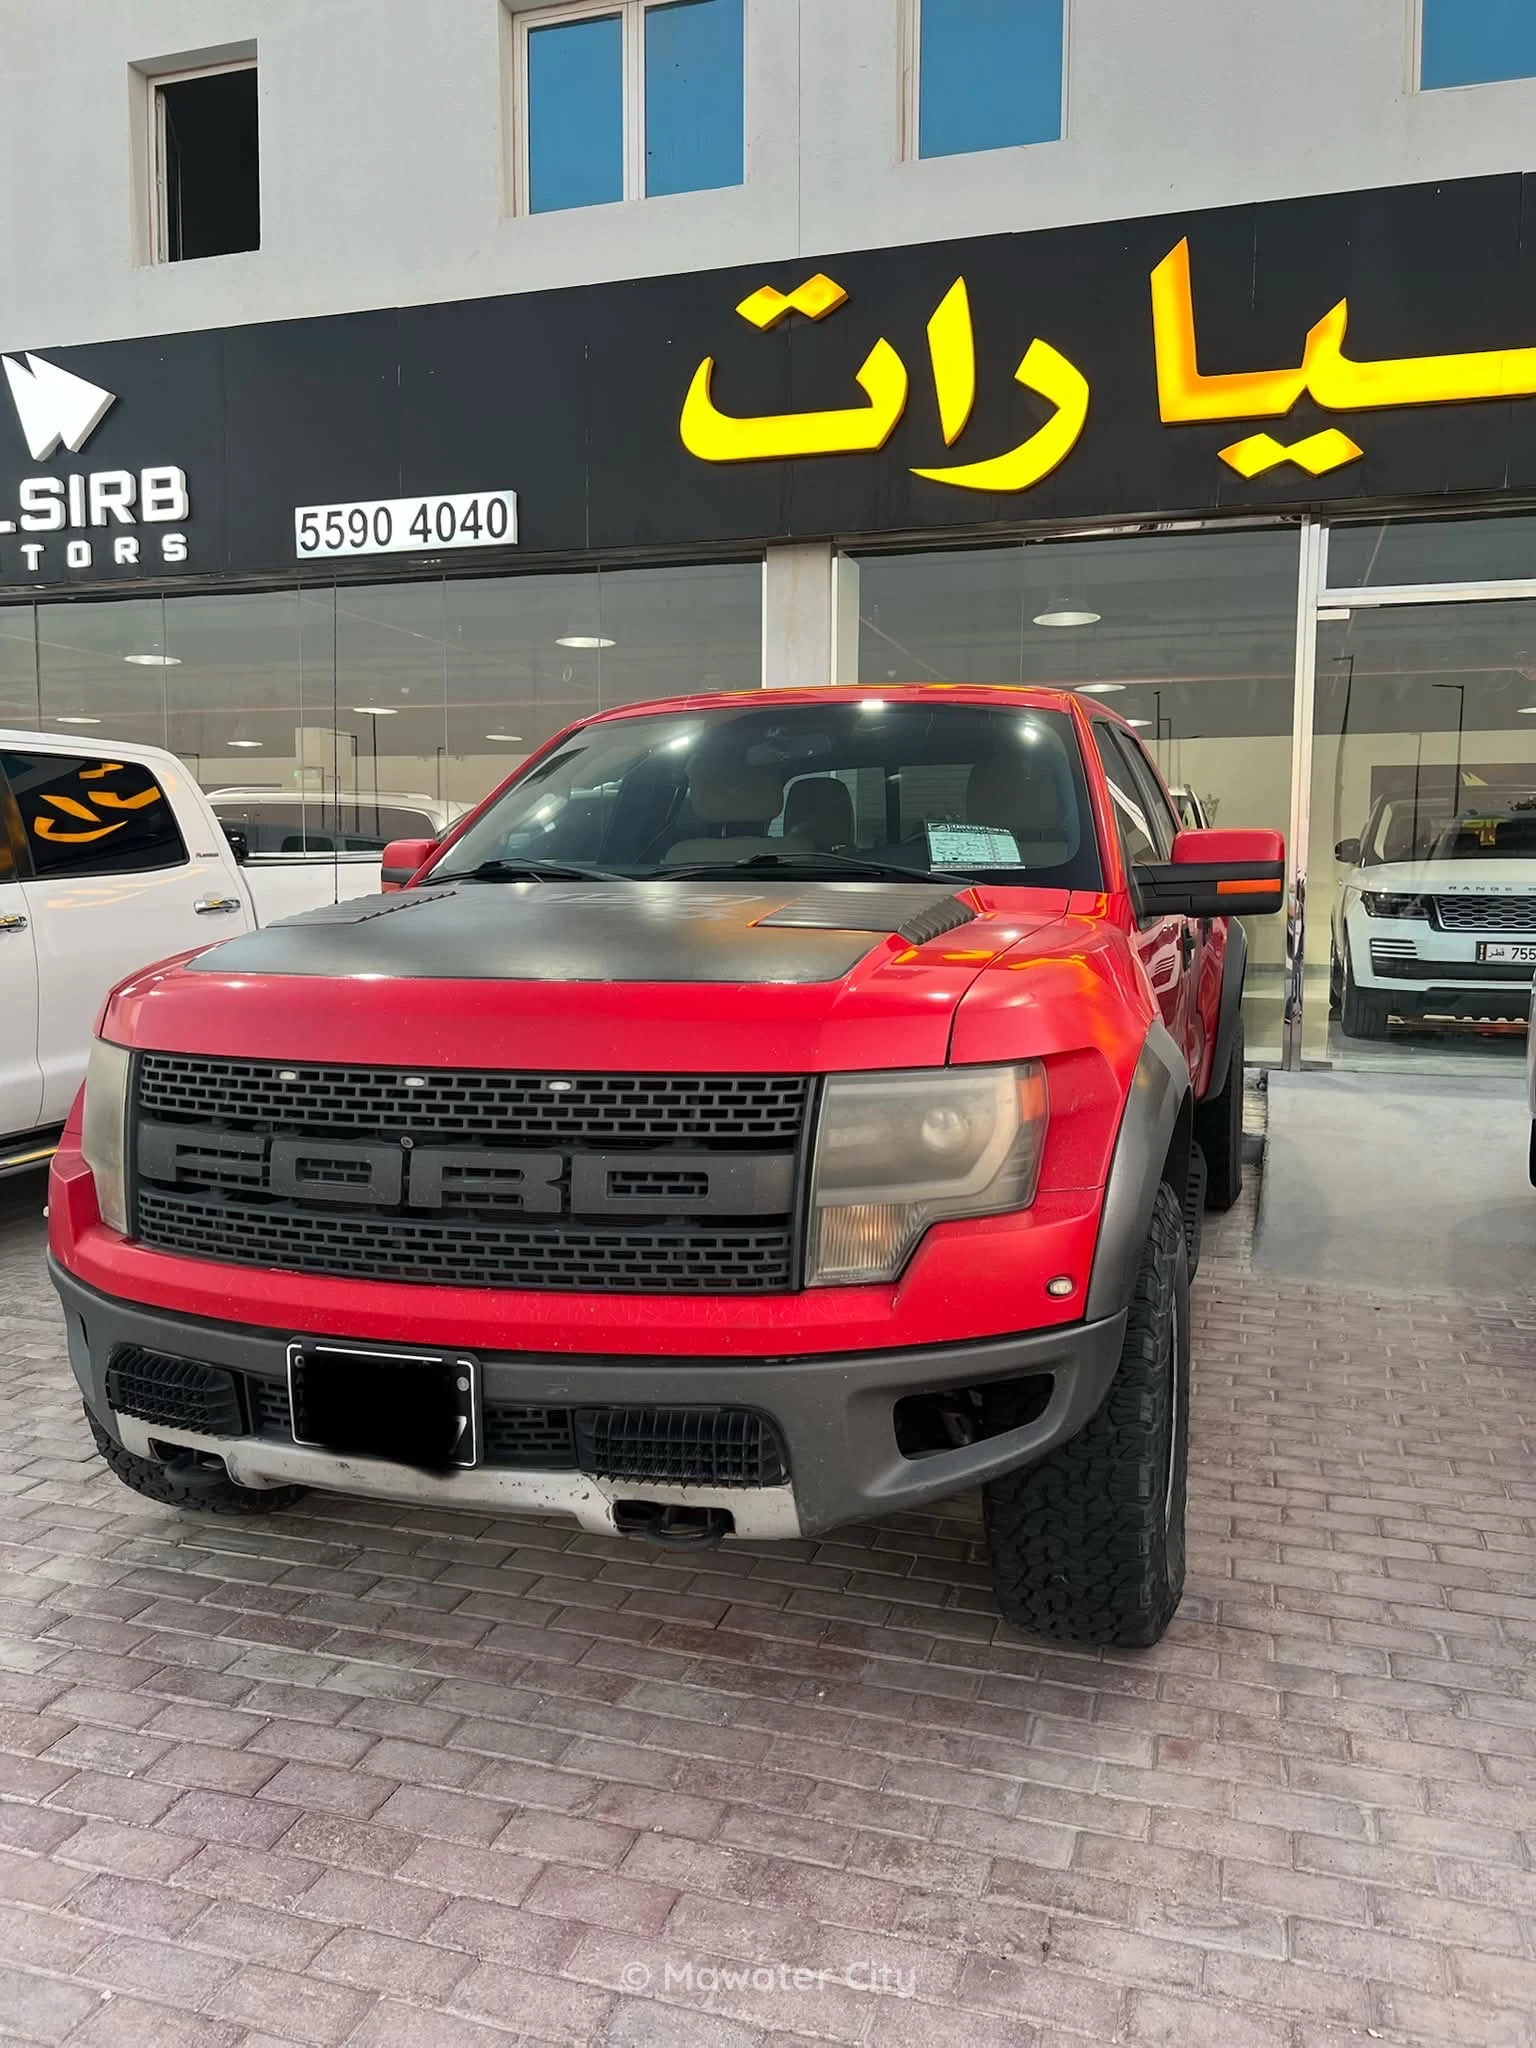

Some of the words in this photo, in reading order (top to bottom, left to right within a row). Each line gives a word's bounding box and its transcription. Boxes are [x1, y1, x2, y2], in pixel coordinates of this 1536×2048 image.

[299, 506, 393, 552] 5590
[409, 497, 508, 544] 4040
[138, 1120, 796, 1216] FORD
